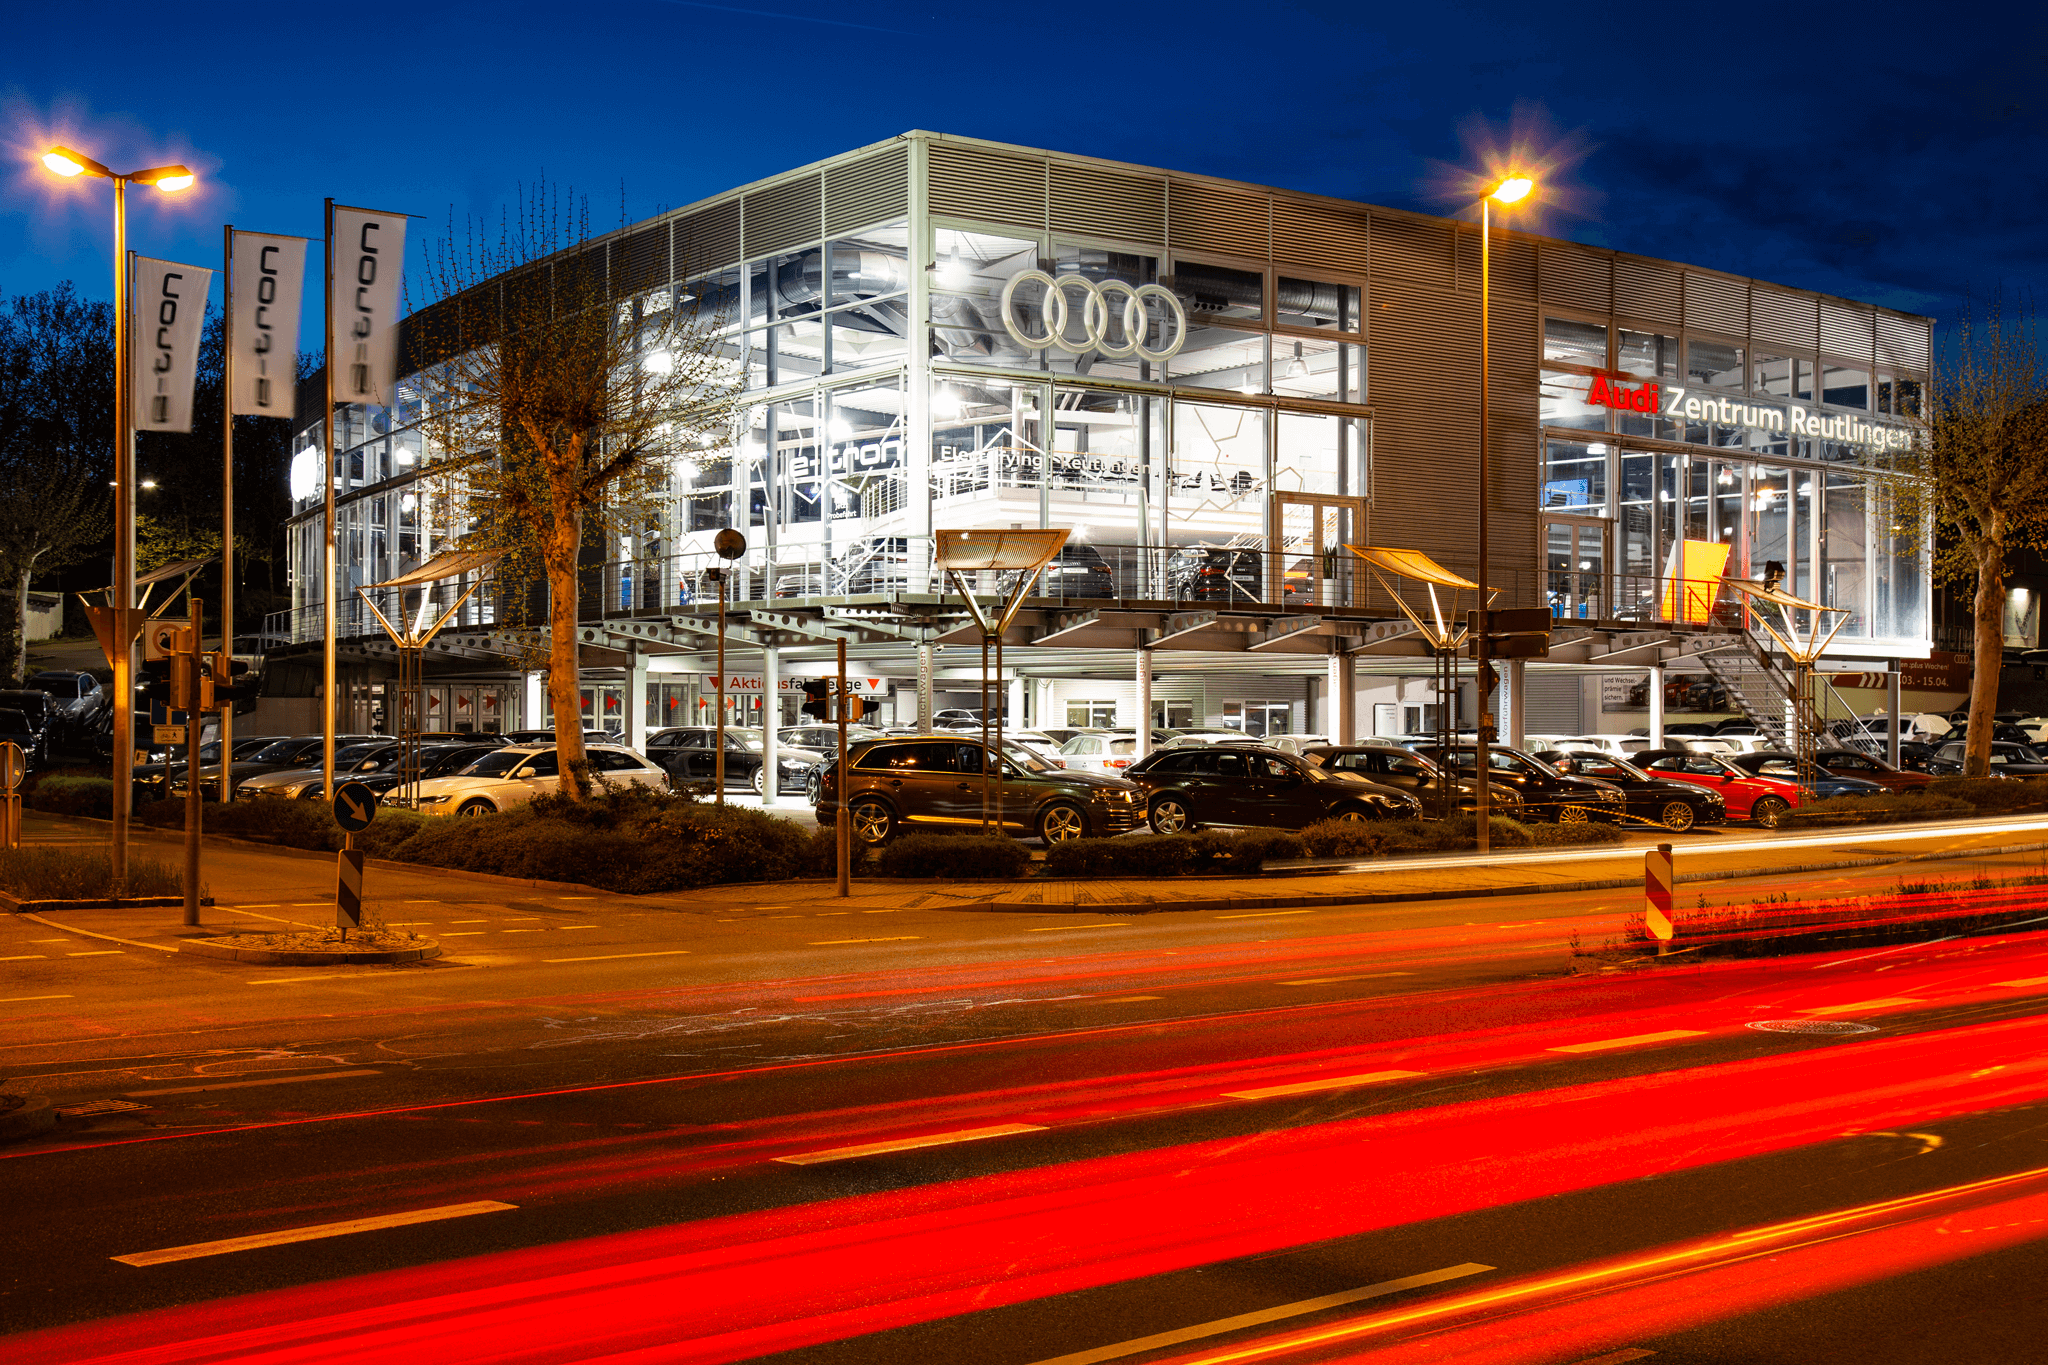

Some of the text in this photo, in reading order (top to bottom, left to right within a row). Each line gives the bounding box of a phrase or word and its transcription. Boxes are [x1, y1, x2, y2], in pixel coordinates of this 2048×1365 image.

[1587, 376, 1912, 452] Audi Zentrum Reutlingen
[789, 440, 901, 478] e-tron
[941, 445, 1043, 469] Elefying
[1924, 662, 1950, 670] Wochen!
[1604, 685, 1621, 693] prämie
[1923, 676, 1949, 687] 15.04.
